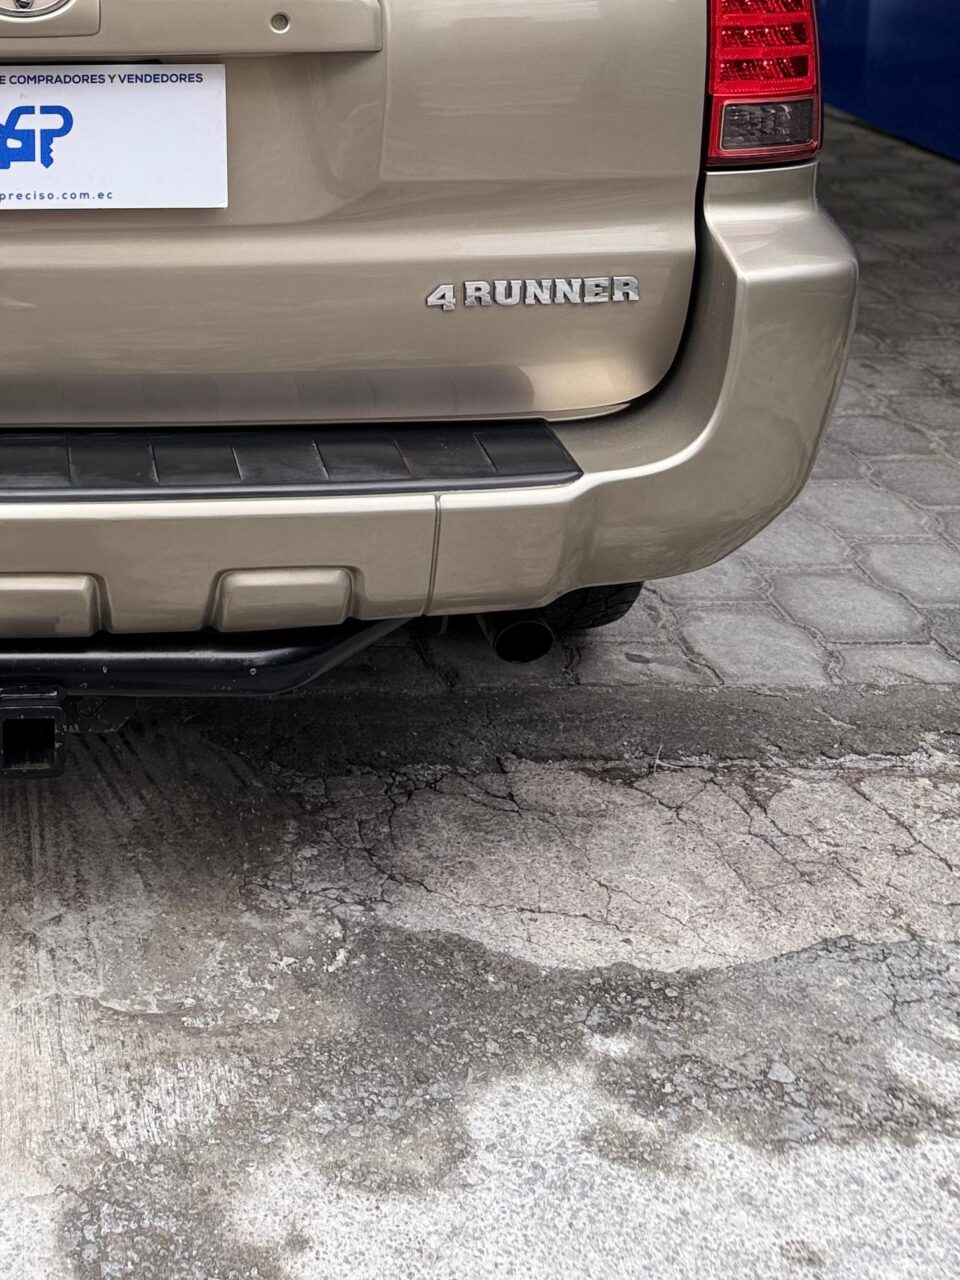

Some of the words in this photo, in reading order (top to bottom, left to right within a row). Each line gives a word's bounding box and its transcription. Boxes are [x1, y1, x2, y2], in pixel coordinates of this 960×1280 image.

[9, 74, 106, 85] COMPRADORES
[108, 74, 117, 84] Y
[118, 73, 204, 84] VENDEDORES
